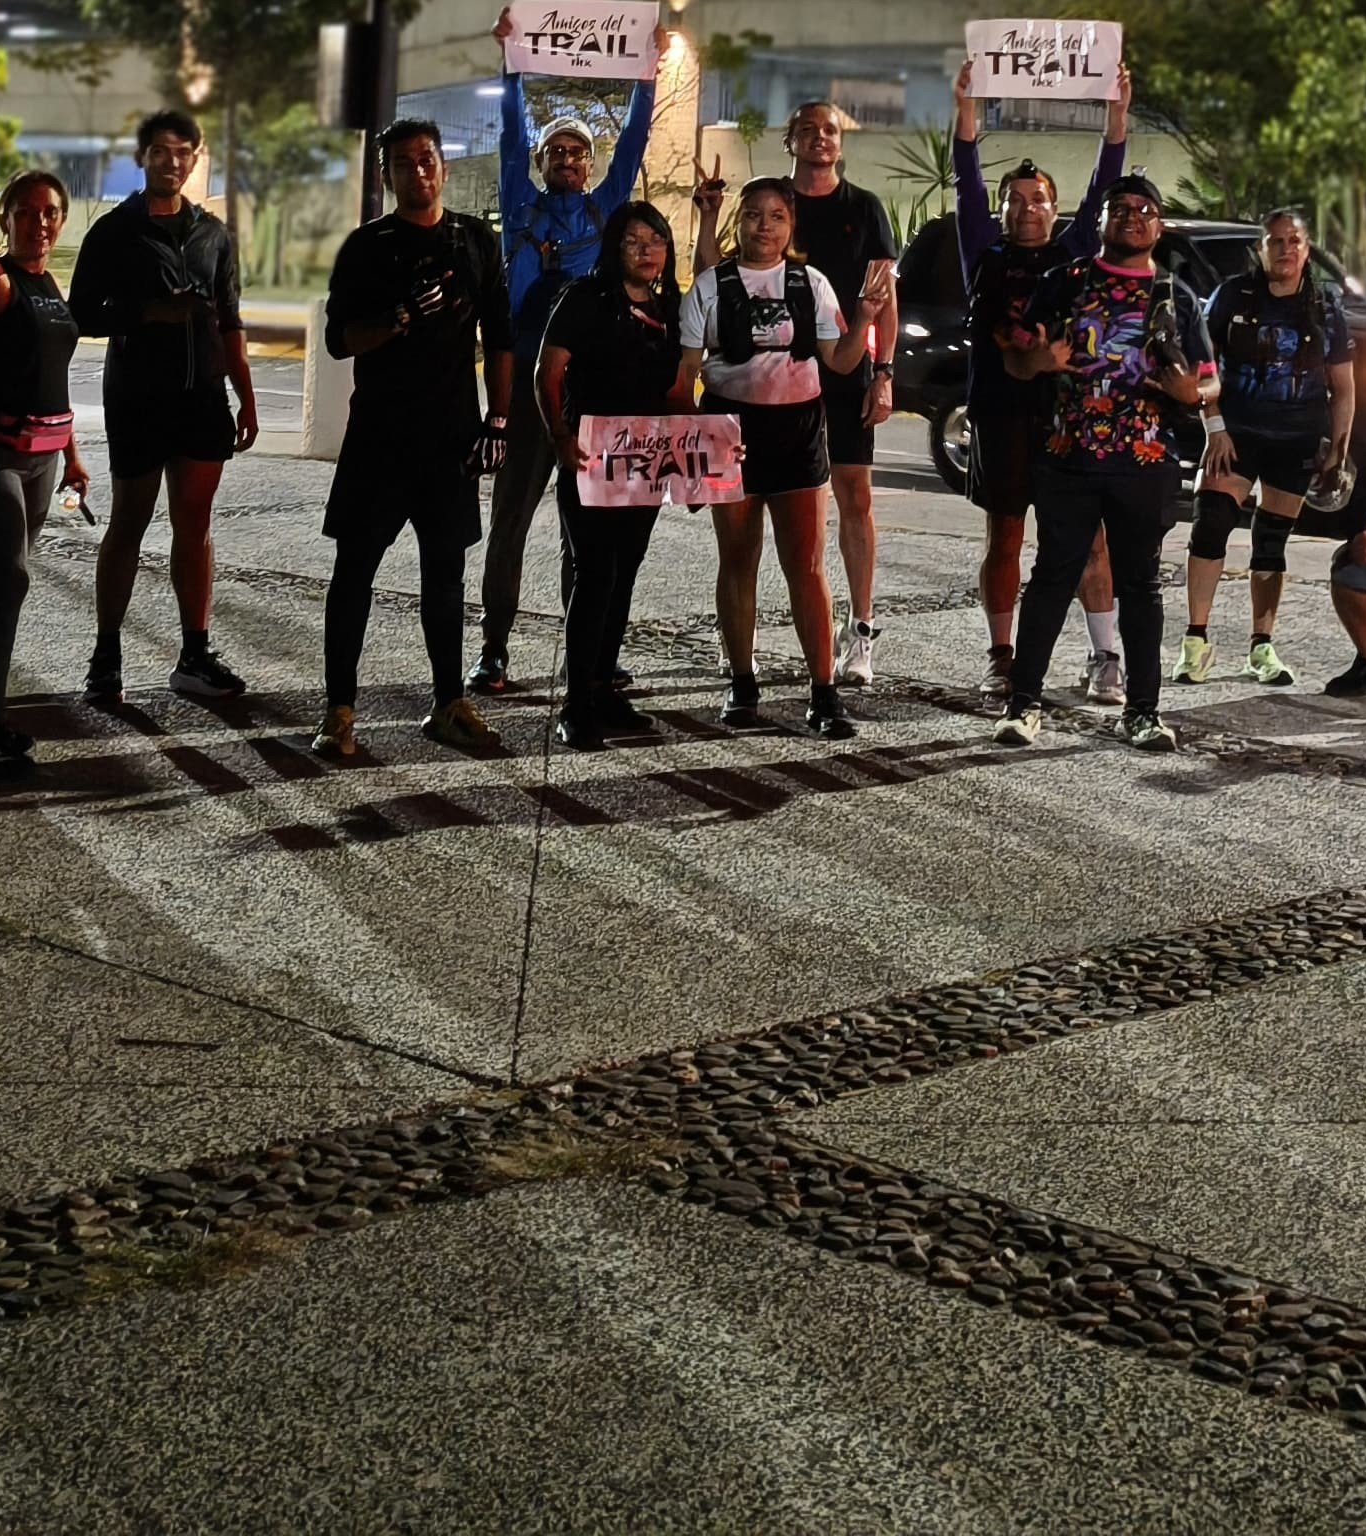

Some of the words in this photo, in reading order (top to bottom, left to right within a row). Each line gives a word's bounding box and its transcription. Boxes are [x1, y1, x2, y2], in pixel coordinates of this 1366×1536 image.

[540, 10, 597, 38] Amigos
[601, 14, 625, 32] del
[524, 31, 639, 58] TRAIL
[1000, 30, 1057, 57] Amigos
[985, 51, 1103, 77] TRAIL
[613, 427, 673, 458] Amigos
[677, 429, 702, 450] del
[597, 451, 724, 481] TRAIL
